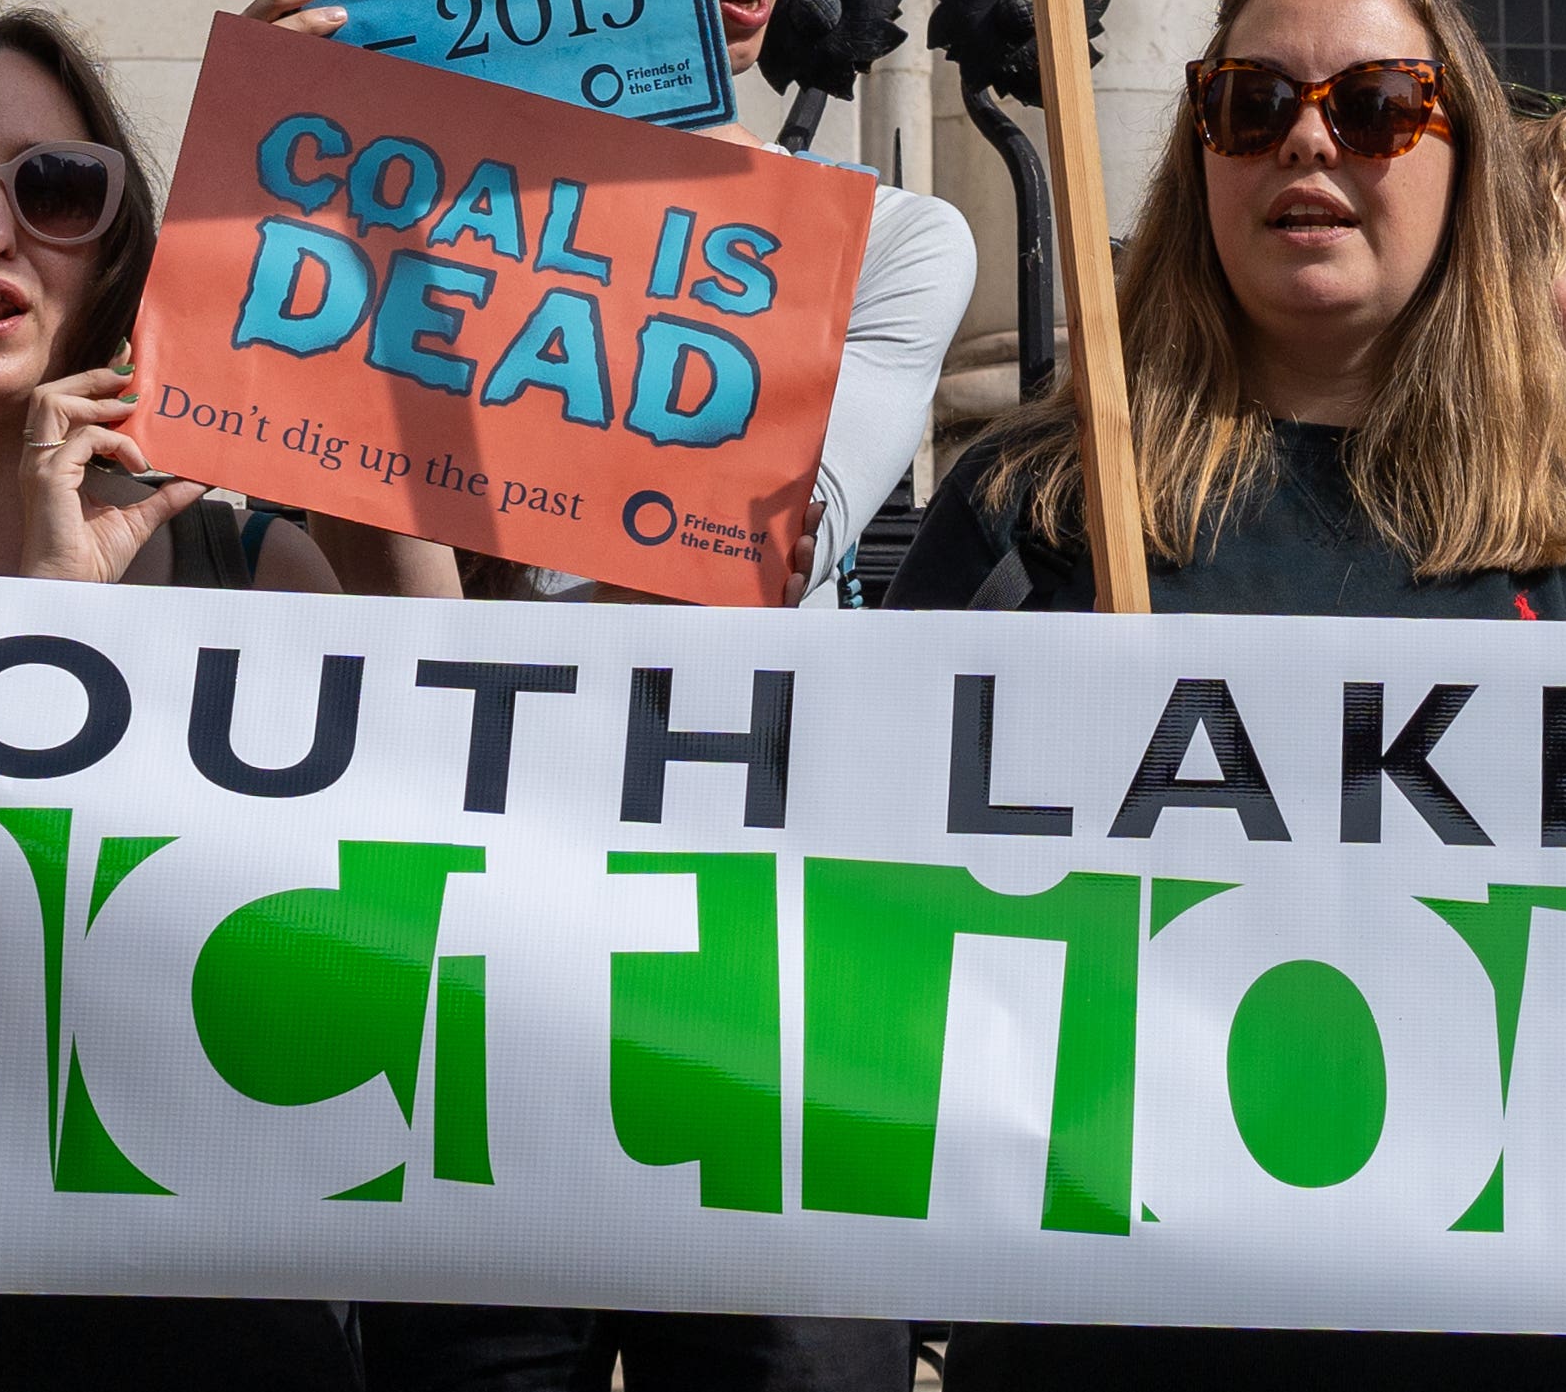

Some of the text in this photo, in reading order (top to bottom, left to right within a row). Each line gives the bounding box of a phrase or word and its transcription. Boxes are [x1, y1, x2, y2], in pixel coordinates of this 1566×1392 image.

[626, 58, 690, 81] Friends of
[629, 73, 692, 95] the Earth
[256, 112, 782, 318] COAL IS
[232, 214, 761, 449] DEAD
[154, 383, 584, 521] Don’t dig up the past
[684, 513, 768, 545] Friends of
[680, 531, 762, 563] the Earth
